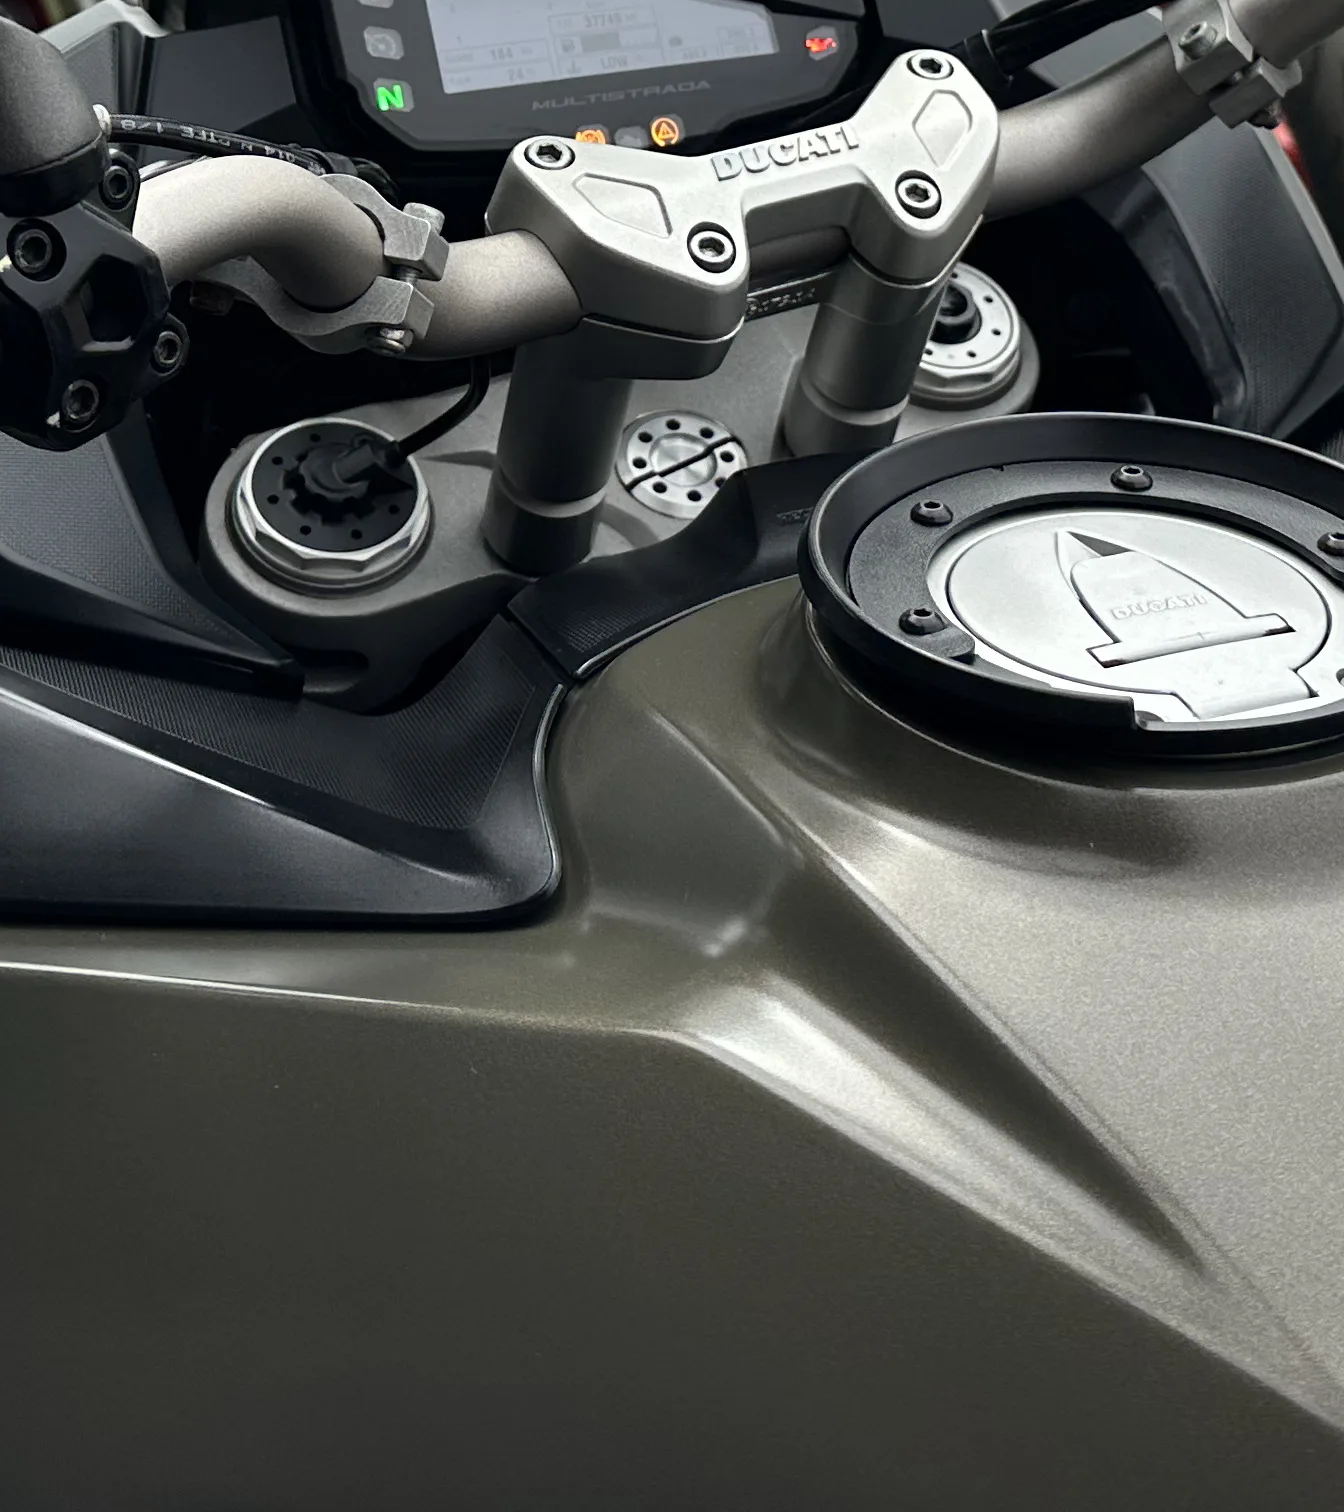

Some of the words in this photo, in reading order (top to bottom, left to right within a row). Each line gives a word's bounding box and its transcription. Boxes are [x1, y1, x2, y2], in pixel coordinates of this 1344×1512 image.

[376, 84, 404, 112] N
[532, 80, 712, 111] MULTISTRADA
[710, 126, 860, 182] DUCATI
[1112, 593, 1208, 620] DUCATI
